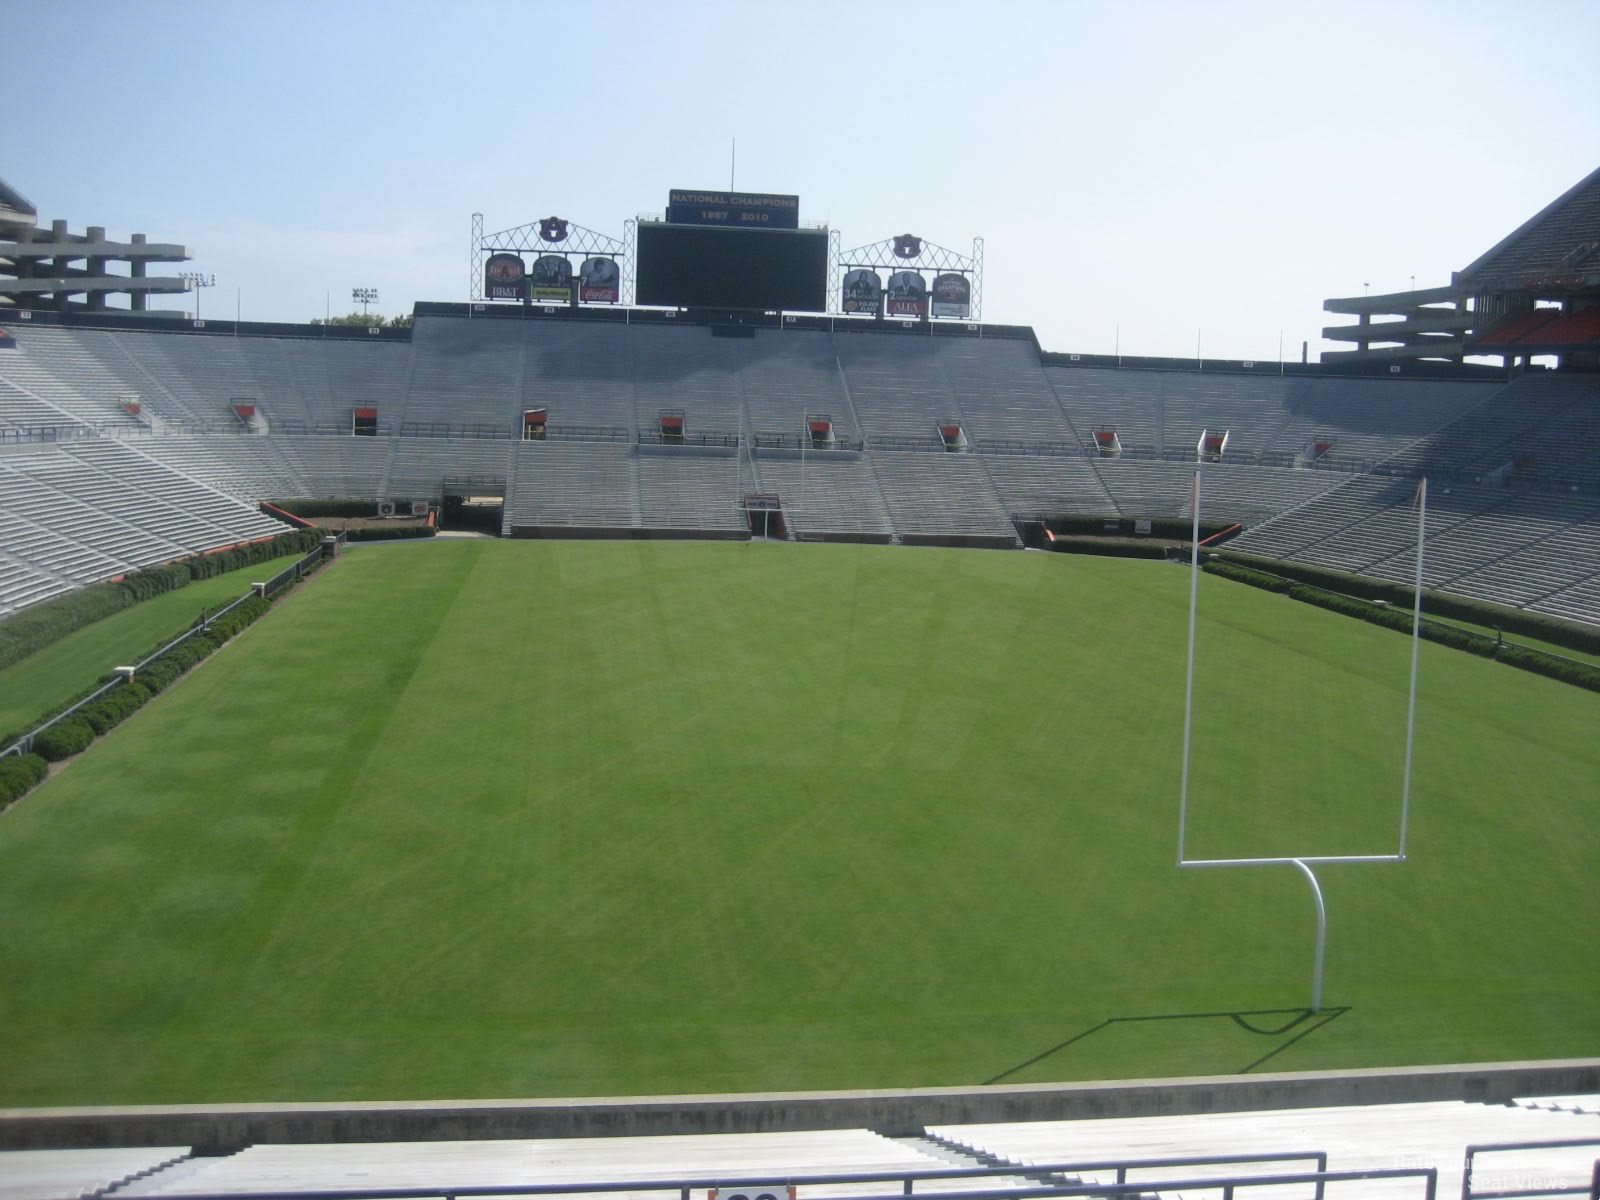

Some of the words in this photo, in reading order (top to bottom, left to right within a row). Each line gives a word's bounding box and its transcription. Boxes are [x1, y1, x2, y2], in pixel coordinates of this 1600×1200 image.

[672, 193, 728, 204] NATIONAL
[730, 197, 797, 208] CHAMPIONS
[741, 212, 769, 221] 2010
[581, 277, 588, 286] 7
[492, 287, 519, 297] BB&T
[585, 289, 613, 300] Coca-Cola
[844, 289, 857, 299] 34
[889, 290, 896, 300] 2
